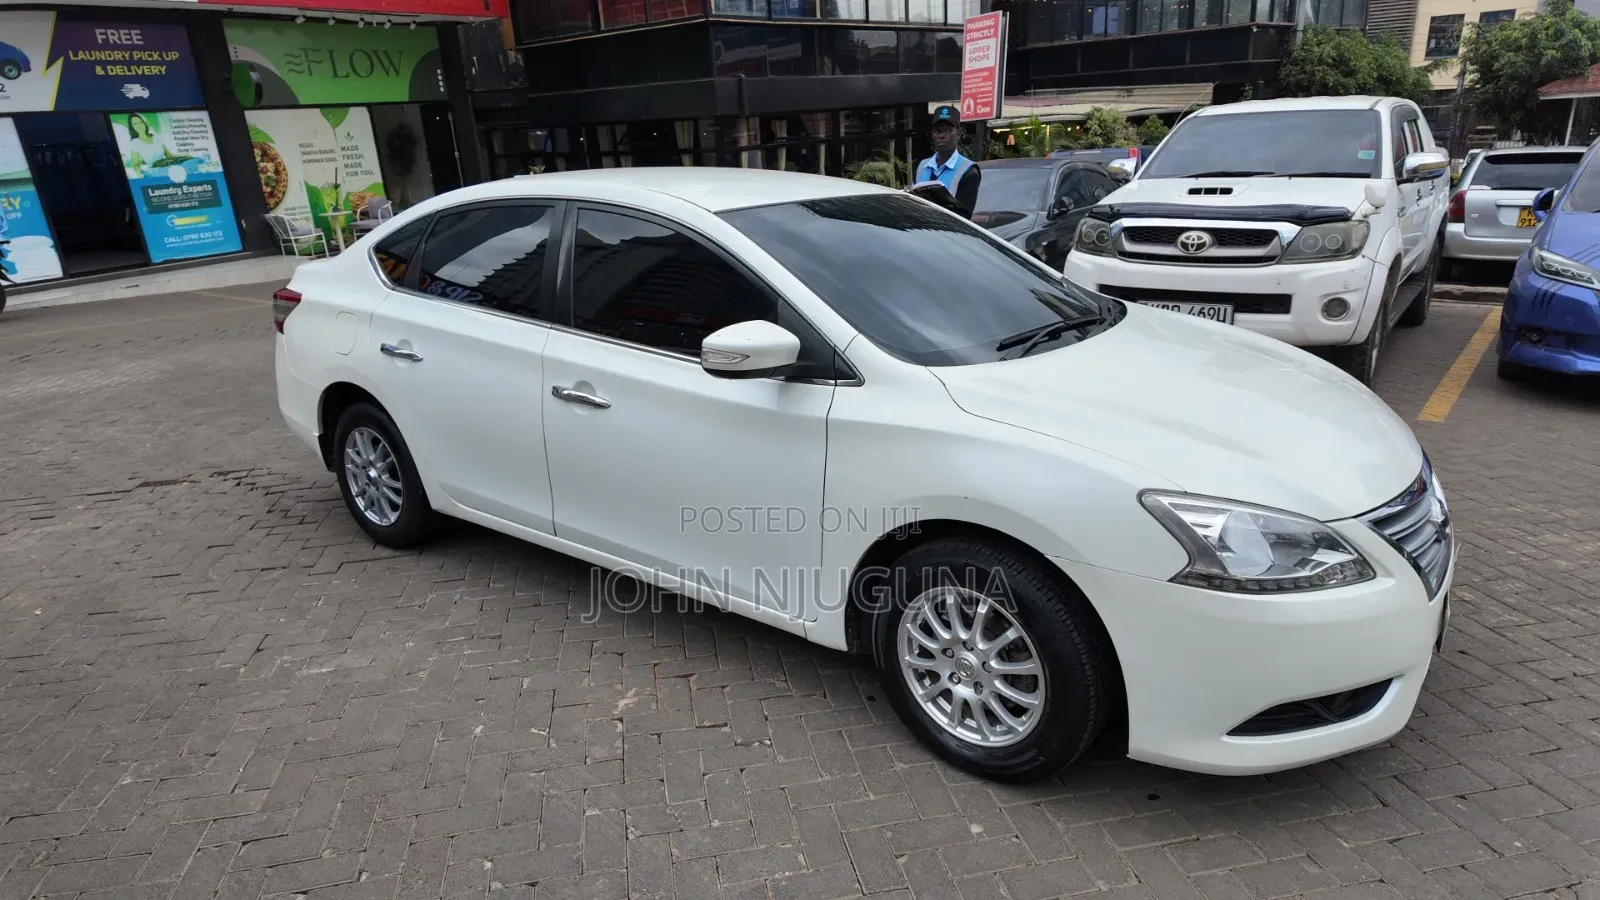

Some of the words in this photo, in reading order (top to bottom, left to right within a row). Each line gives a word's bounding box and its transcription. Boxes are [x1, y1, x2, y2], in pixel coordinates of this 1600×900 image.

[967, 19, 995, 30] PARKING
[95, 28, 144, 45] FREE
[966, 28, 995, 40] STRICTLY
[69, 50, 130, 61] LAUNDRY
[133, 51, 162, 61] PICK
[164, 51, 180, 61] UP
[968, 45, 990, 55] UPPER
[301, 46, 404, 79] FLOW
[968, 54, 990, 63] SHOPS
[95, 66, 105, 75] &
[107, 65, 167, 76] DELIVERY
[342, 153, 366, 161] FRESH.
[148, 186, 183, 197] Laundry
[182, 184, 213, 194] Experts
